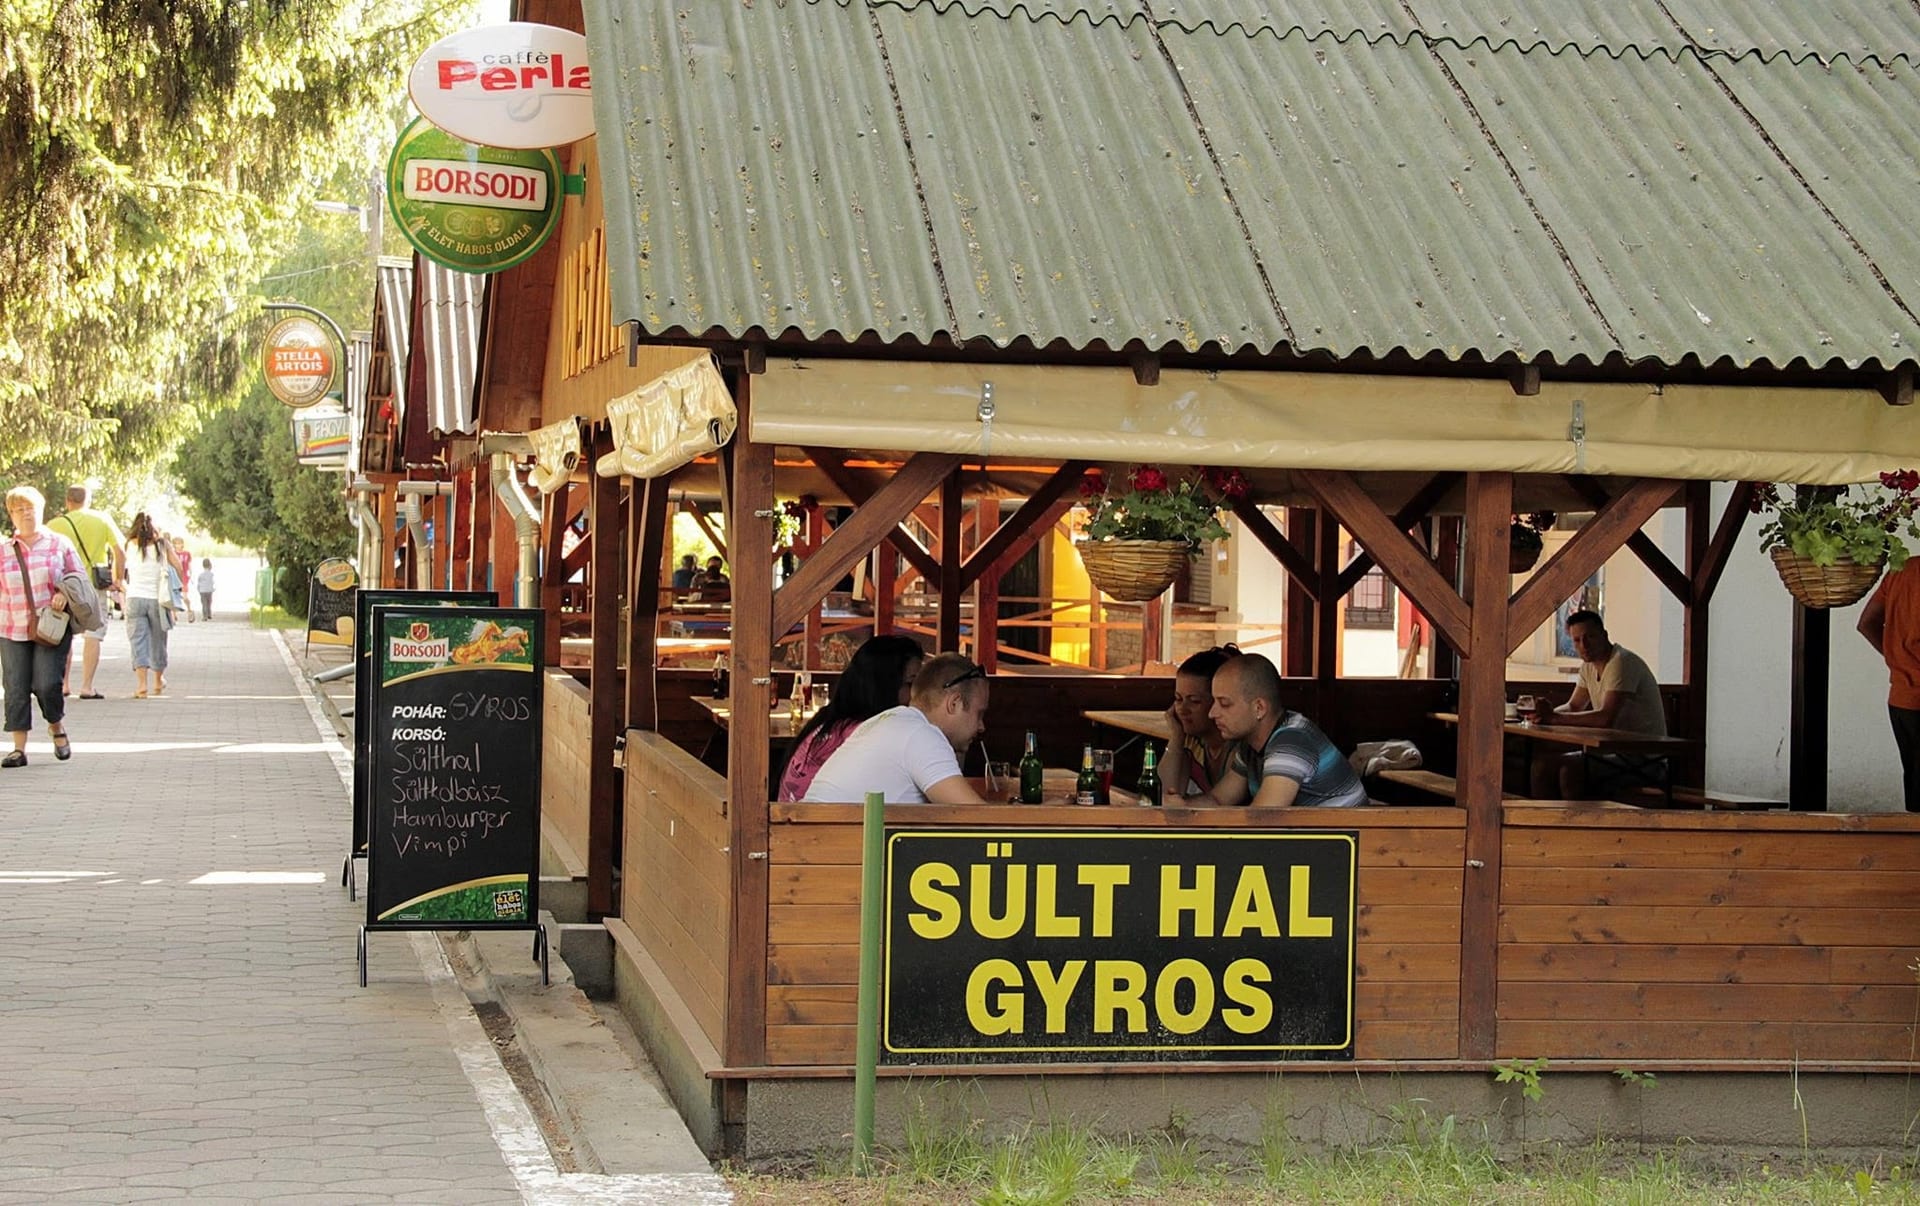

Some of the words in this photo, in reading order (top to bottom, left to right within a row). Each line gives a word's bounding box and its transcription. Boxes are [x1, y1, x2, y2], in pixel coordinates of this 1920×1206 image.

[483, 51, 548, 65] caffè
[437, 54, 592, 91] Perla
[415, 167, 537, 201] BORSODI
[427, 225, 454, 249] ÉLET
[456, 243, 493, 255] HABOS
[494, 223, 532, 252] OLDALA
[274, 351, 322, 361] STELLA
[274, 361, 323, 371] ARTOIS
[393, 643, 446, 658] BORSODI
[391, 703, 447, 719] POHÁR:
[450, 692, 530, 721] GYROS
[391, 727, 447, 742] KORSÓ:
[393, 806, 511, 839] Hamburger
[392, 832, 468, 859] Vimpi
[907, 842, 1131, 940] SÜLT
[1158, 863, 1333, 938] HAL
[965, 957, 1274, 1036] GYROS
